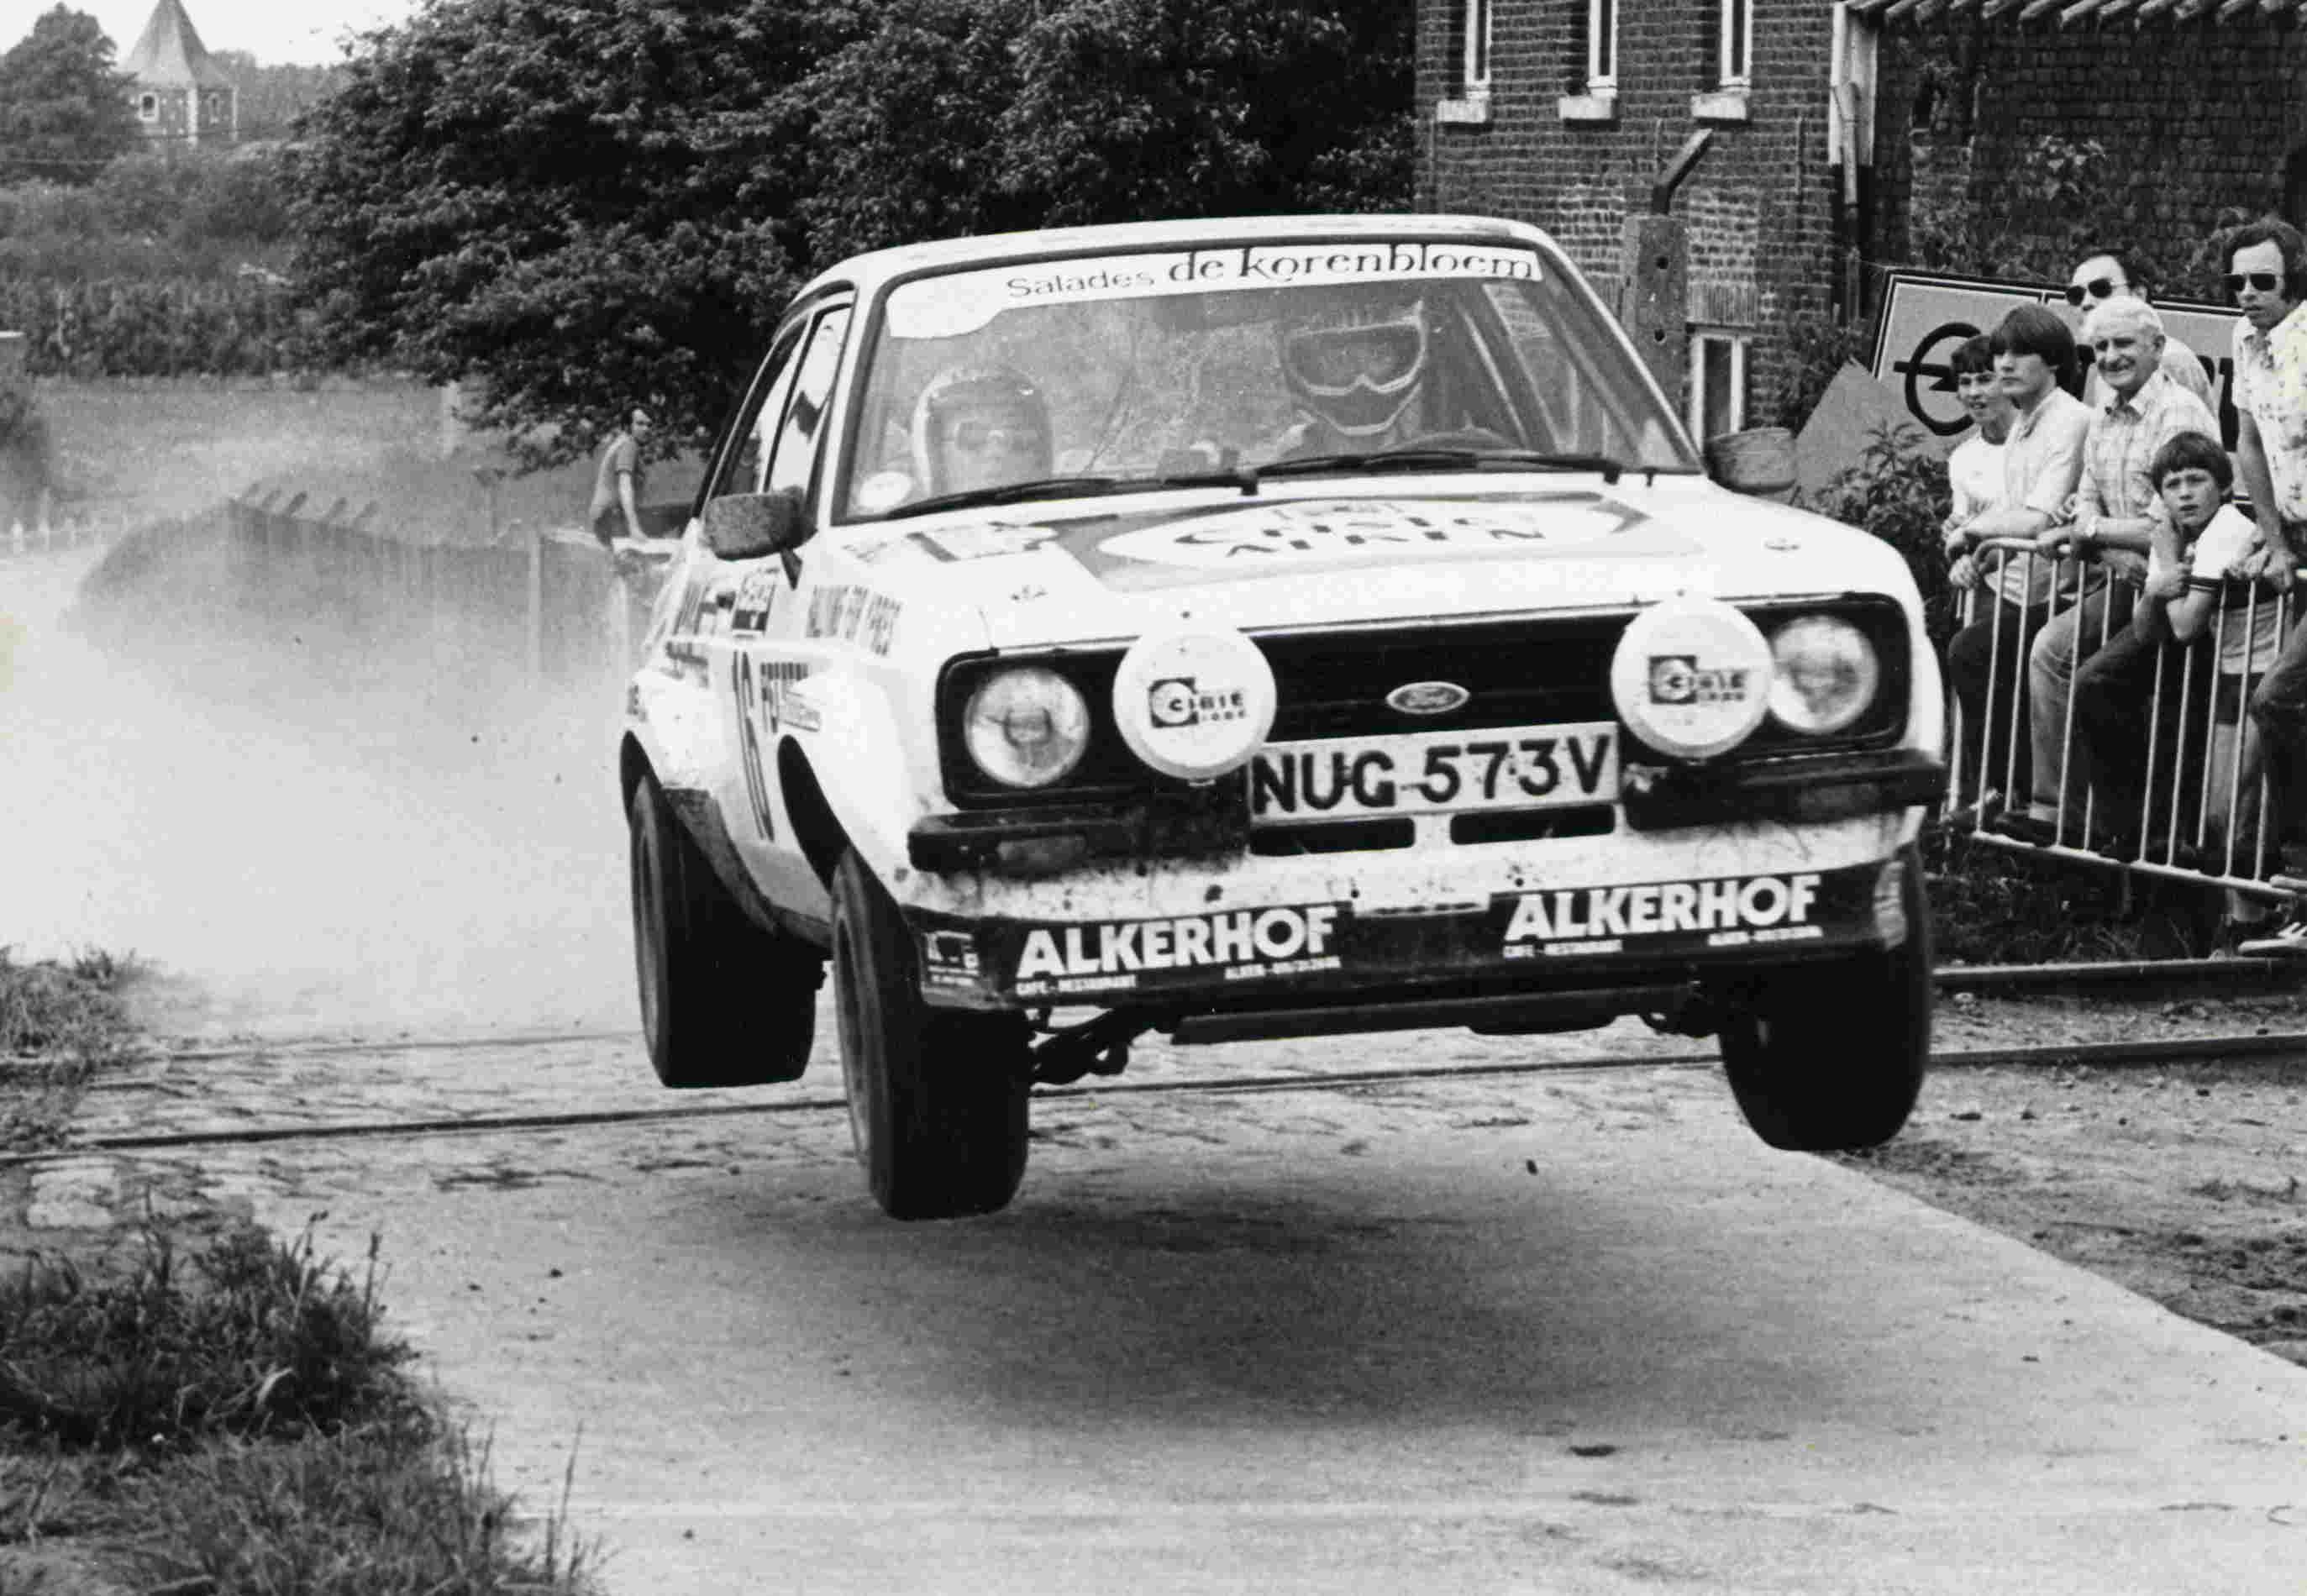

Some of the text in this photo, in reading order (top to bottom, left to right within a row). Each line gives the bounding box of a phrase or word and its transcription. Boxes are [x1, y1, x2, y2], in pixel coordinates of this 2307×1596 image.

[1006, 244, 1532, 297] Salades de korenbloem
[1251, 733, 1611, 815] NUG 573V
[1015, 905, 1338, 979] ALKERHOF
[1504, 873, 1822, 942] ALKERHOF
